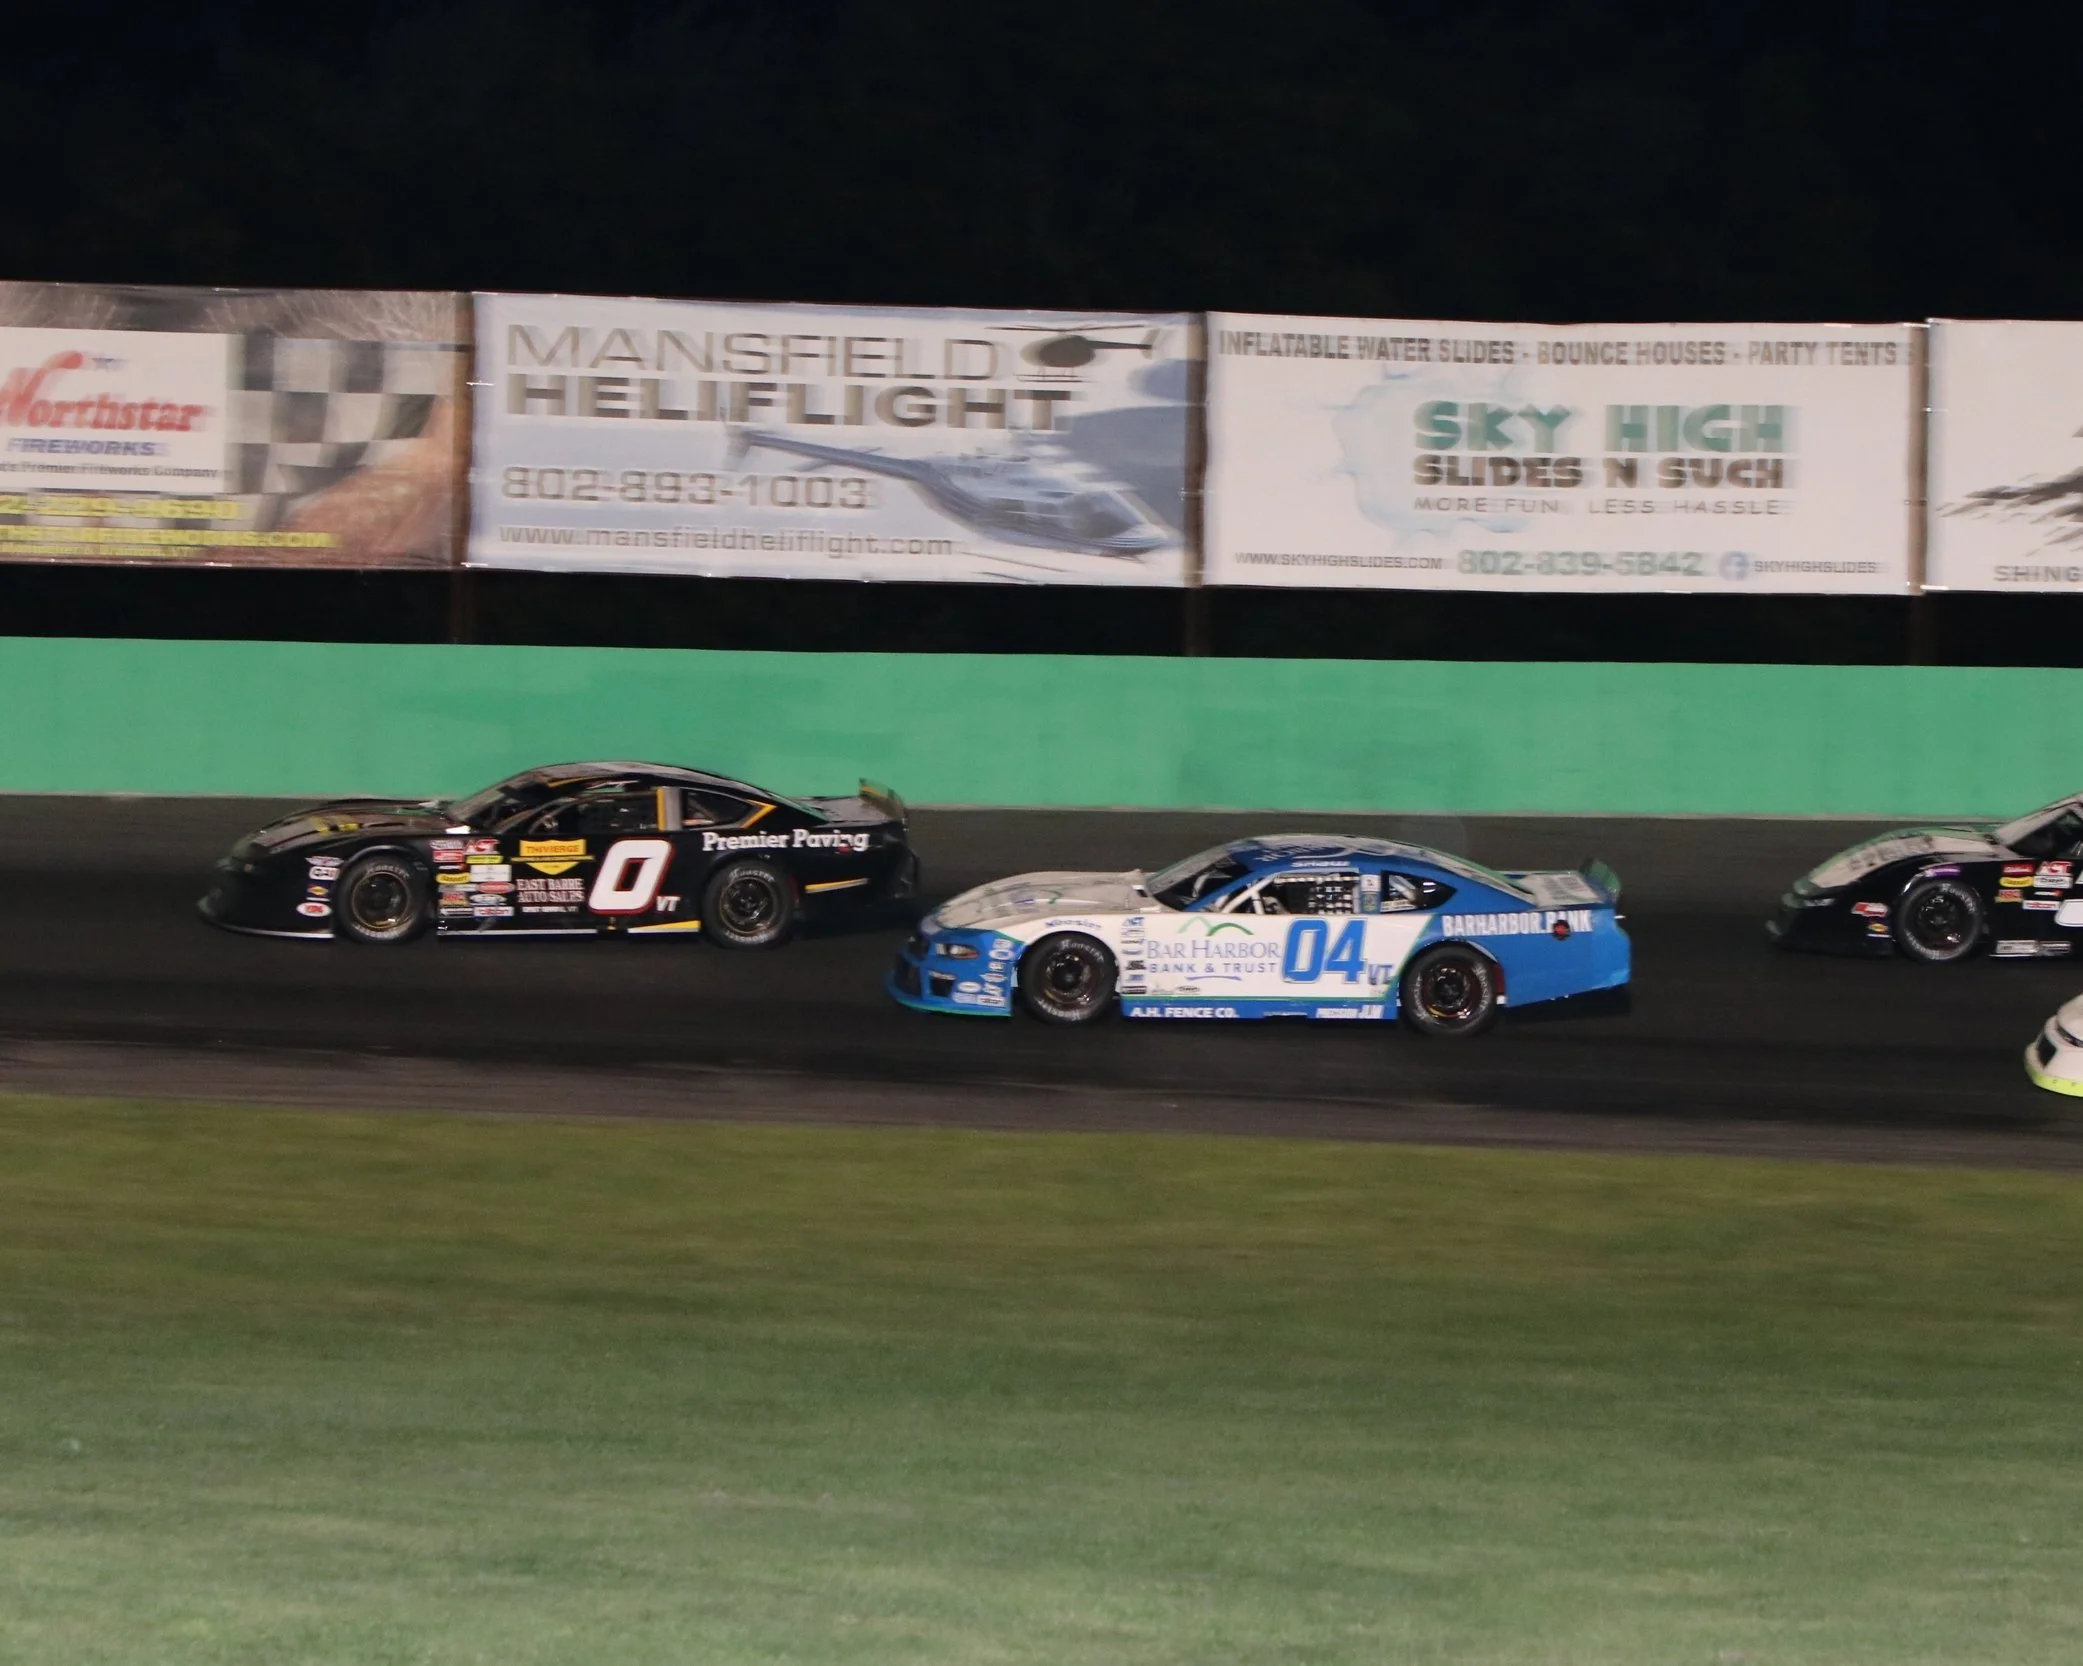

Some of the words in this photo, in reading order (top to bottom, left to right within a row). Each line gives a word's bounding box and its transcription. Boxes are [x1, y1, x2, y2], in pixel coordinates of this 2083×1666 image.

[507, 324, 999, 381] MANSFIELD
[1219, 330, 1350, 359] INFLATABLE
[1357, 335, 1431, 362] WATER
[1439, 339, 1514, 364] SLIDES
[1537, 341, 1628, 365] BOUNCE
[1636, 342, 1726, 365] HOUSES
[1748, 341, 1817, 365] PARTY
[1826, 341, 1897, 365] TENTS
[507, 373, 1071, 430] HELIFLIGHT
[1413, 400, 1574, 453] SKY
[1604, 404, 1784, 453] HIGH
[9, 437, 158, 456] FIREWORKS
[1413, 454, 1584, 487] SLIDES
[1603, 457, 1639, 488] N
[1657, 458, 1784, 489] SUCH
[501, 466, 868, 510] 802-893-1003
[1414, 497, 1488, 513] MORE
[1589, 499, 1655, 514] LESS
[1674, 499, 1780, 515] HASSLE
[500, 525, 954, 559] www.mansfieldheliflight.com
[1235, 552, 1442, 570] WWW.SKYHIGHSLIDES.COM
[1458, 550, 1702, 576] 802-839-5842
[1754, 561, 1877, 574] SKYHIGHSLIDES
[702, 831, 789, 851] Premier
[793, 828, 870, 852] Paving
[516, 878, 546, 891] EAST
[548, 878, 586, 891] BARRE
[588, 838, 672, 914] 0
[518, 890, 547, 903] AUTO
[549, 890, 586, 903] SALES
[656, 896, 681, 912] VT
[1147, 940, 1186, 959] BAR
[1191, 939, 1282, 960] HARBOR
[1281, 918, 1368, 984] 04
[1150, 963, 1197, 974] BANK
[1204, 963, 1215, 973] &
[1222, 963, 1277, 974] TRUST
[1130, 1007, 1162, 1018] A.H.
[1164, 1007, 1214, 1018] FENCE
[1215, 1007, 1240, 1018] CO.
